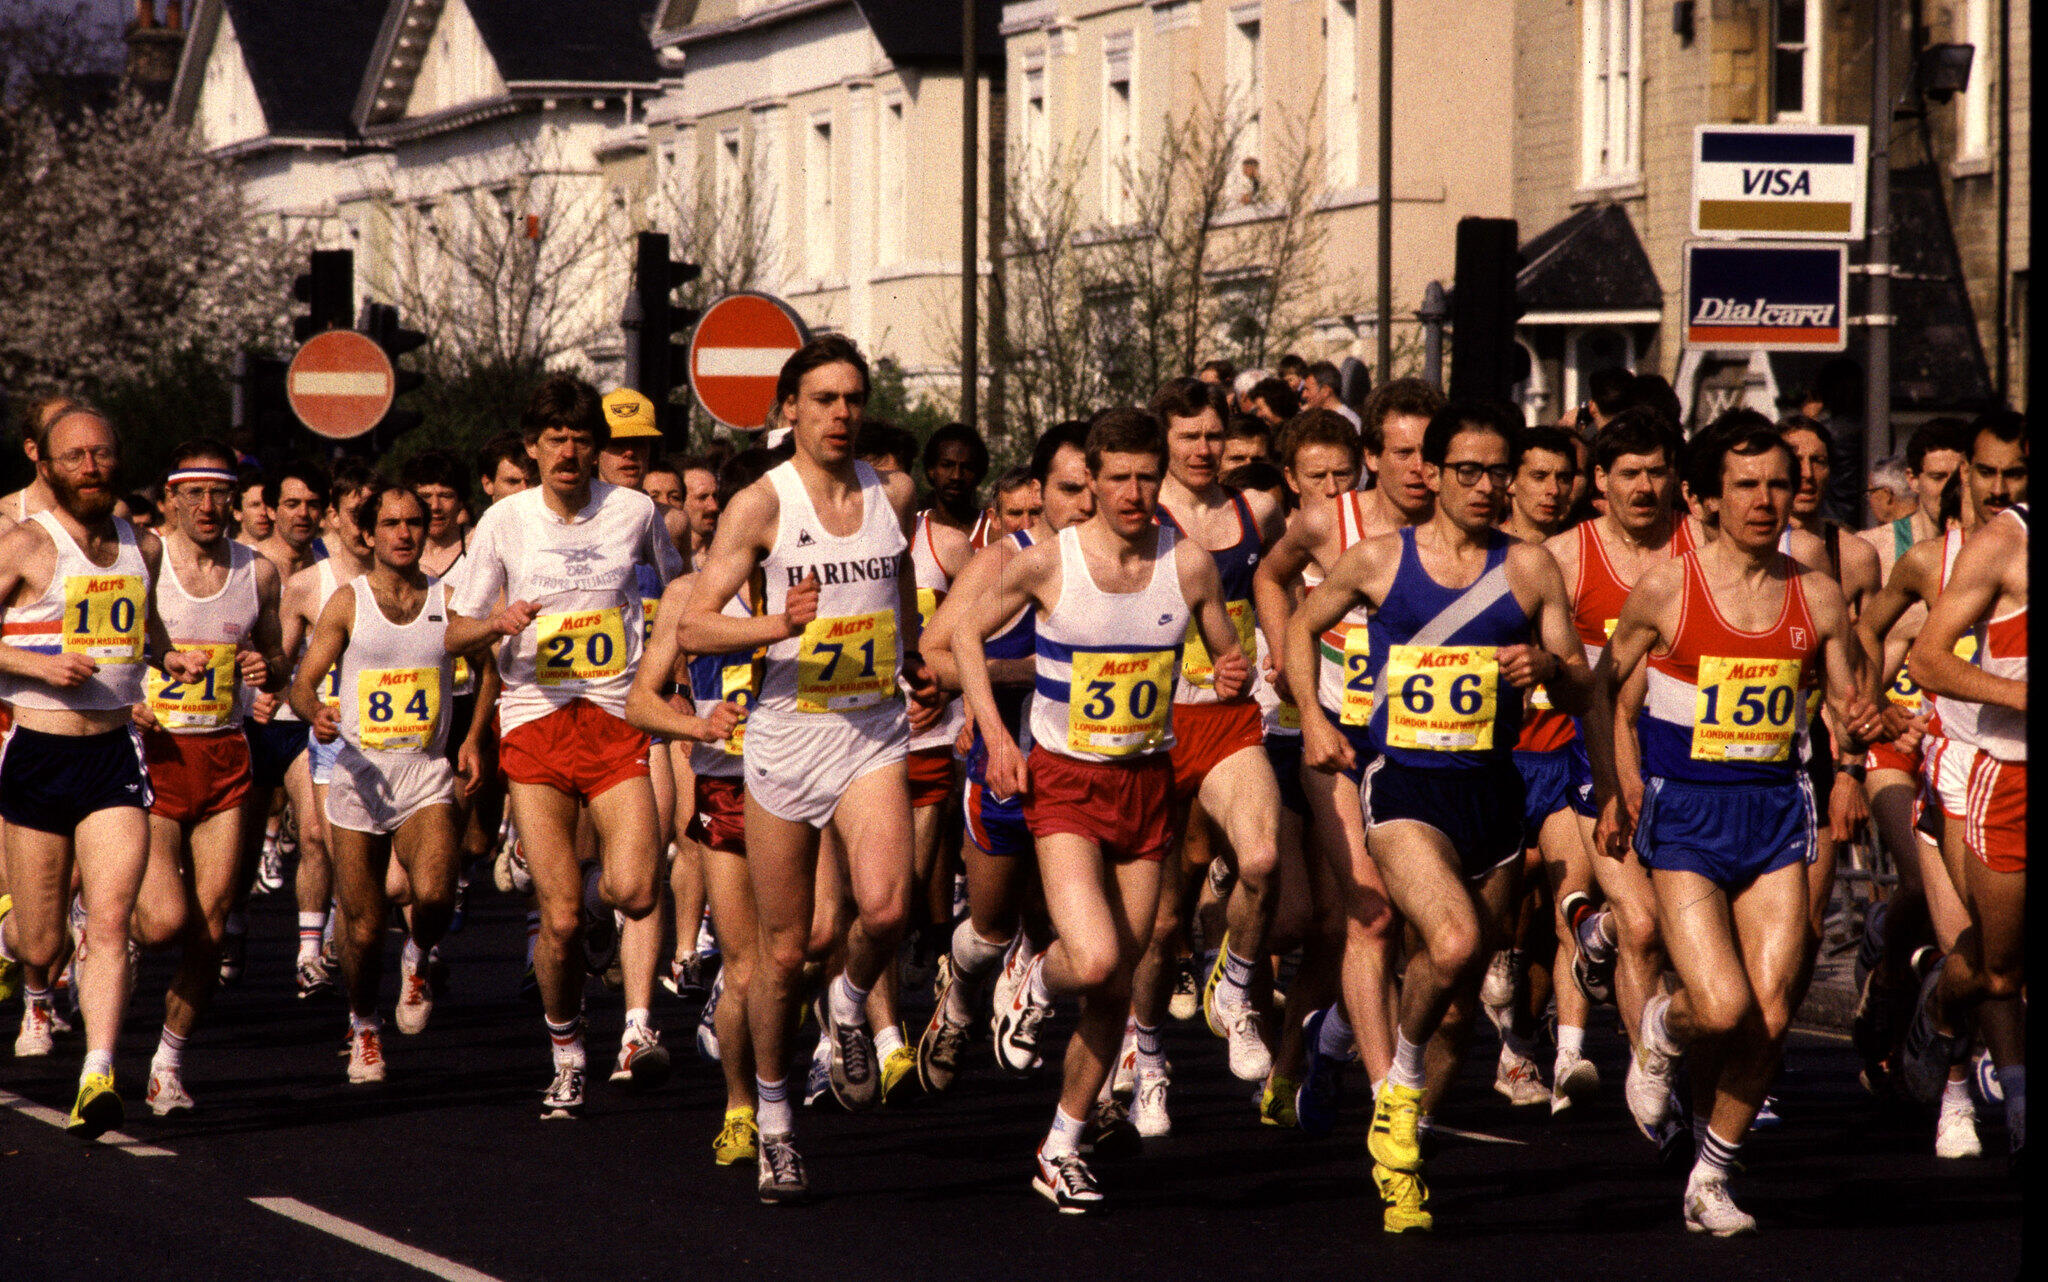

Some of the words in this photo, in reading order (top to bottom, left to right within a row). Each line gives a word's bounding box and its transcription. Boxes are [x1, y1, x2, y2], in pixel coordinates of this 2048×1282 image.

[1742, 169, 1811, 196] VISA
[1692, 297, 1836, 327] Dialcard
[85, 579, 126, 594] Mars
[74, 597, 136, 634] 10
[558, 613, 602, 632] Mars
[826, 617, 875, 639] Mars
[66, 637, 95, 646] LONDON
[547, 633, 613, 668] 20
[812, 638, 877, 682] 71
[1097, 658, 1150, 677] Mars
[1415, 652, 1470, 669] Mars
[378, 672, 419, 687] Mars
[1725, 663, 1779, 681] Mars
[158, 667, 216, 701] 21
[1082, 679, 1158, 720] 30
[1347, 695, 1374, 707] LONDO
[1401, 673, 1483, 715] 66
[151, 701, 180, 711] LONDON
[368, 689, 430, 723] 84
[1699, 684, 1795, 727] 150
[1074, 722, 1108, 733] LONDON
[1395, 716, 1428, 728] LONDON
[1700, 729, 1735, 741] LONDON
[1736, 731, 1779, 741] MARATHON
